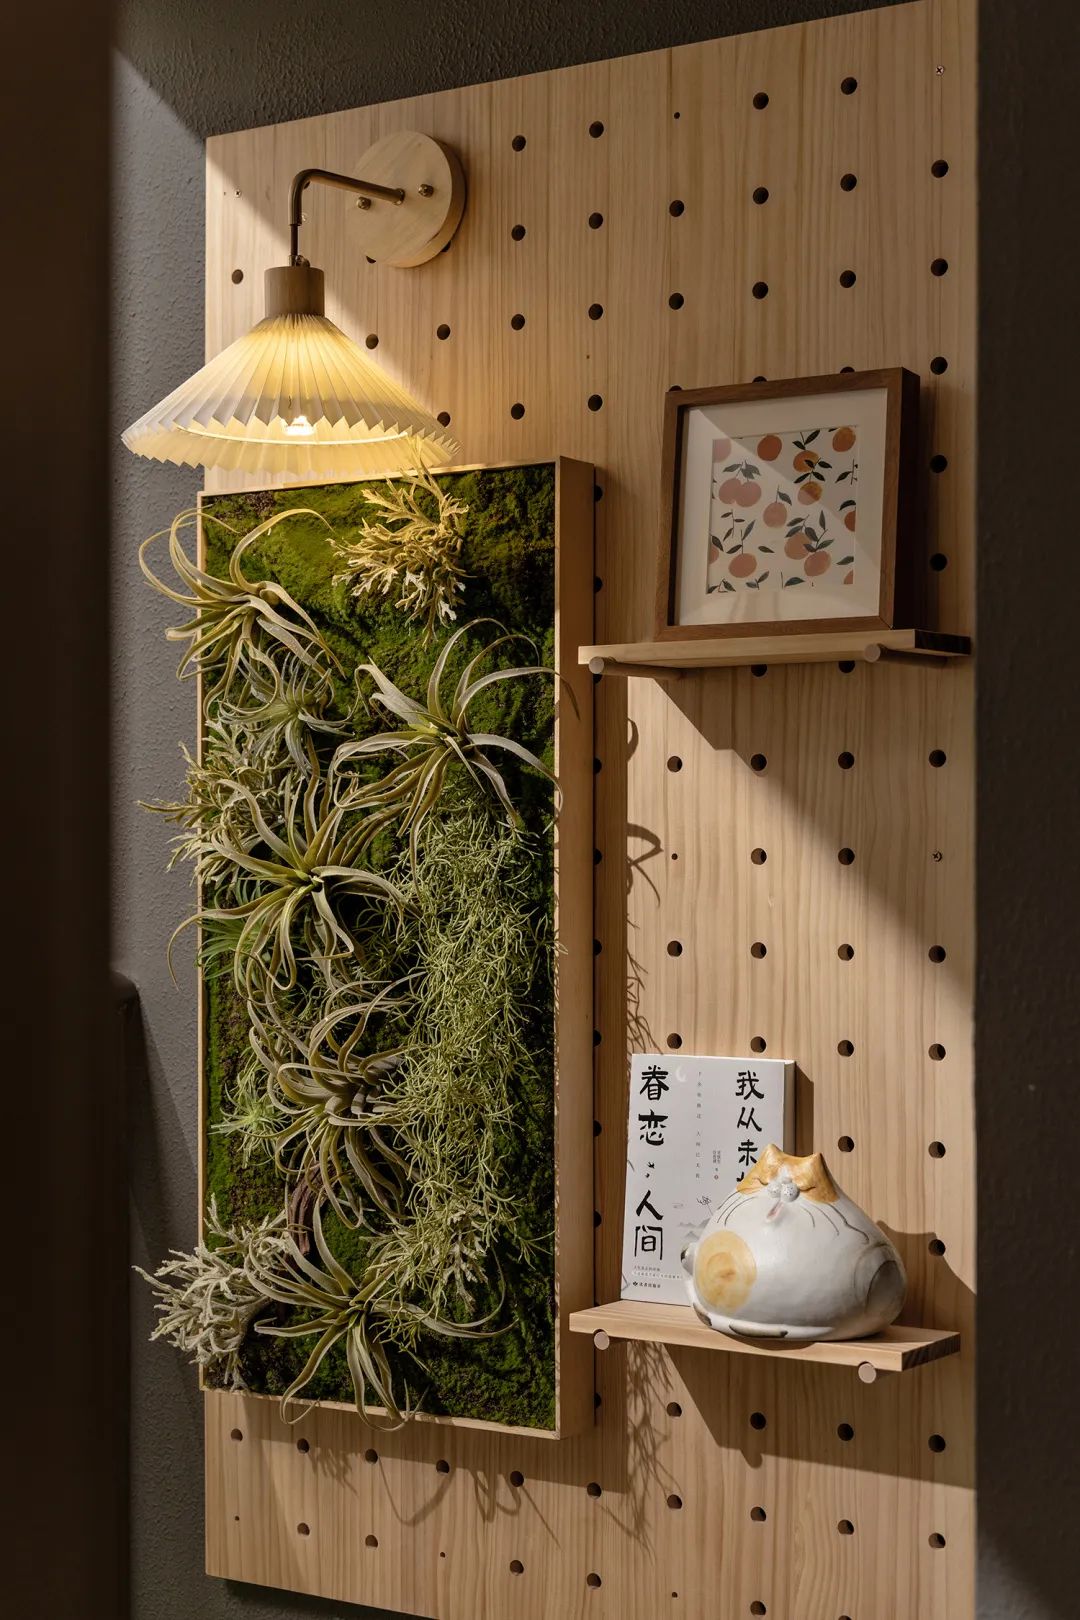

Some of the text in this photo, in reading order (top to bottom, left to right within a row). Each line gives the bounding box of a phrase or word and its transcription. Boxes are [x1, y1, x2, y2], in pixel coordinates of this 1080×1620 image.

[635, 1065, 669, 1260] 眷恋人间
[736, 1070, 764, 1182] 我从未
